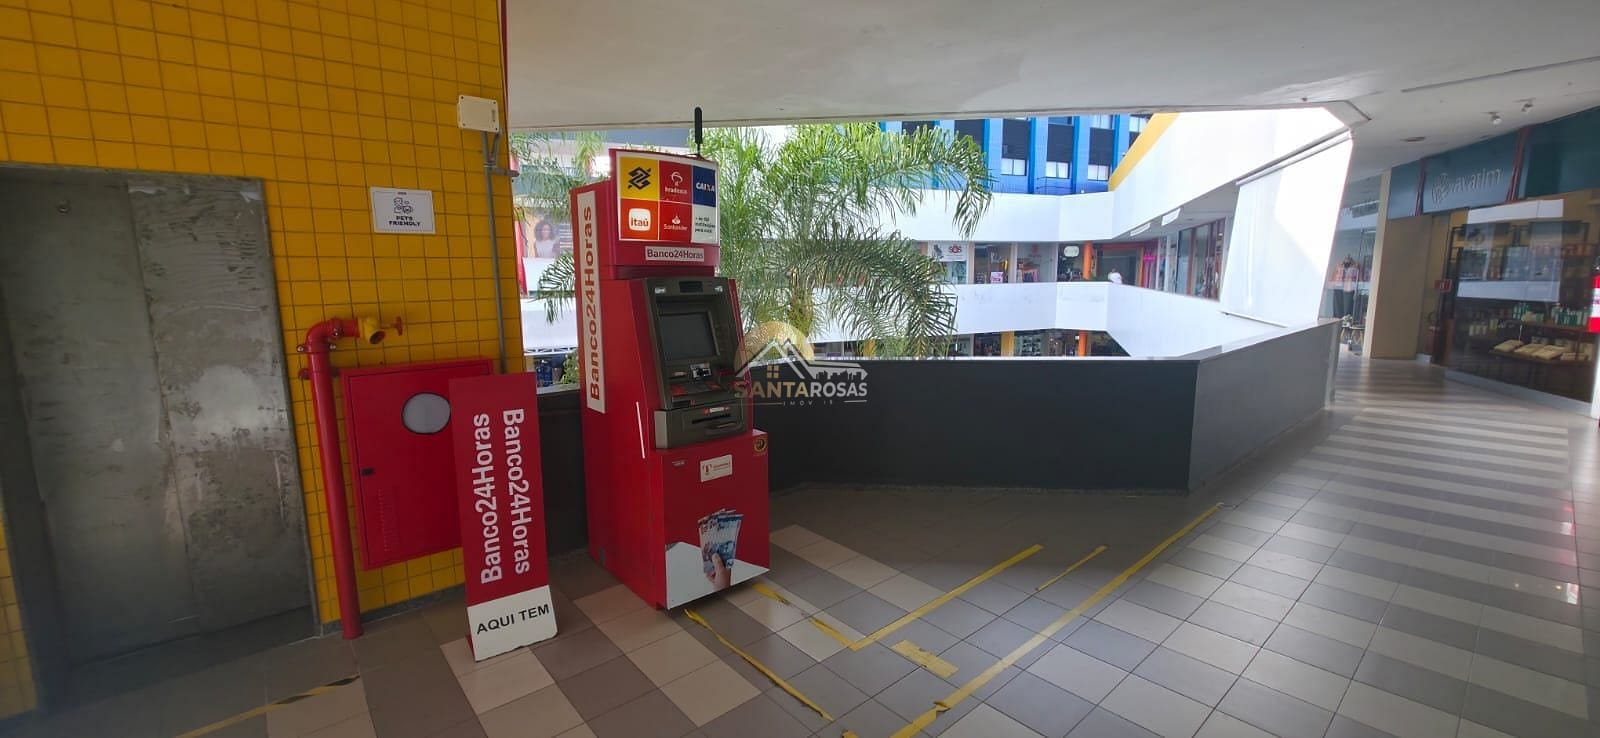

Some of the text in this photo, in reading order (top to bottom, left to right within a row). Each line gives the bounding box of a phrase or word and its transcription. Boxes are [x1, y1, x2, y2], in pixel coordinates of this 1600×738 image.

[696, 182, 714, 192] CAIXA
[630, 216, 649, 227] itaú
[647, 249, 703, 259] Banco24Horas
[583, 206, 600, 401] Banco24Horas
[472, 413, 503, 585] Banco24Horas
[503, 408, 533, 576] Banco24Horas
[476, 603, 550, 635] AQUI TEM
